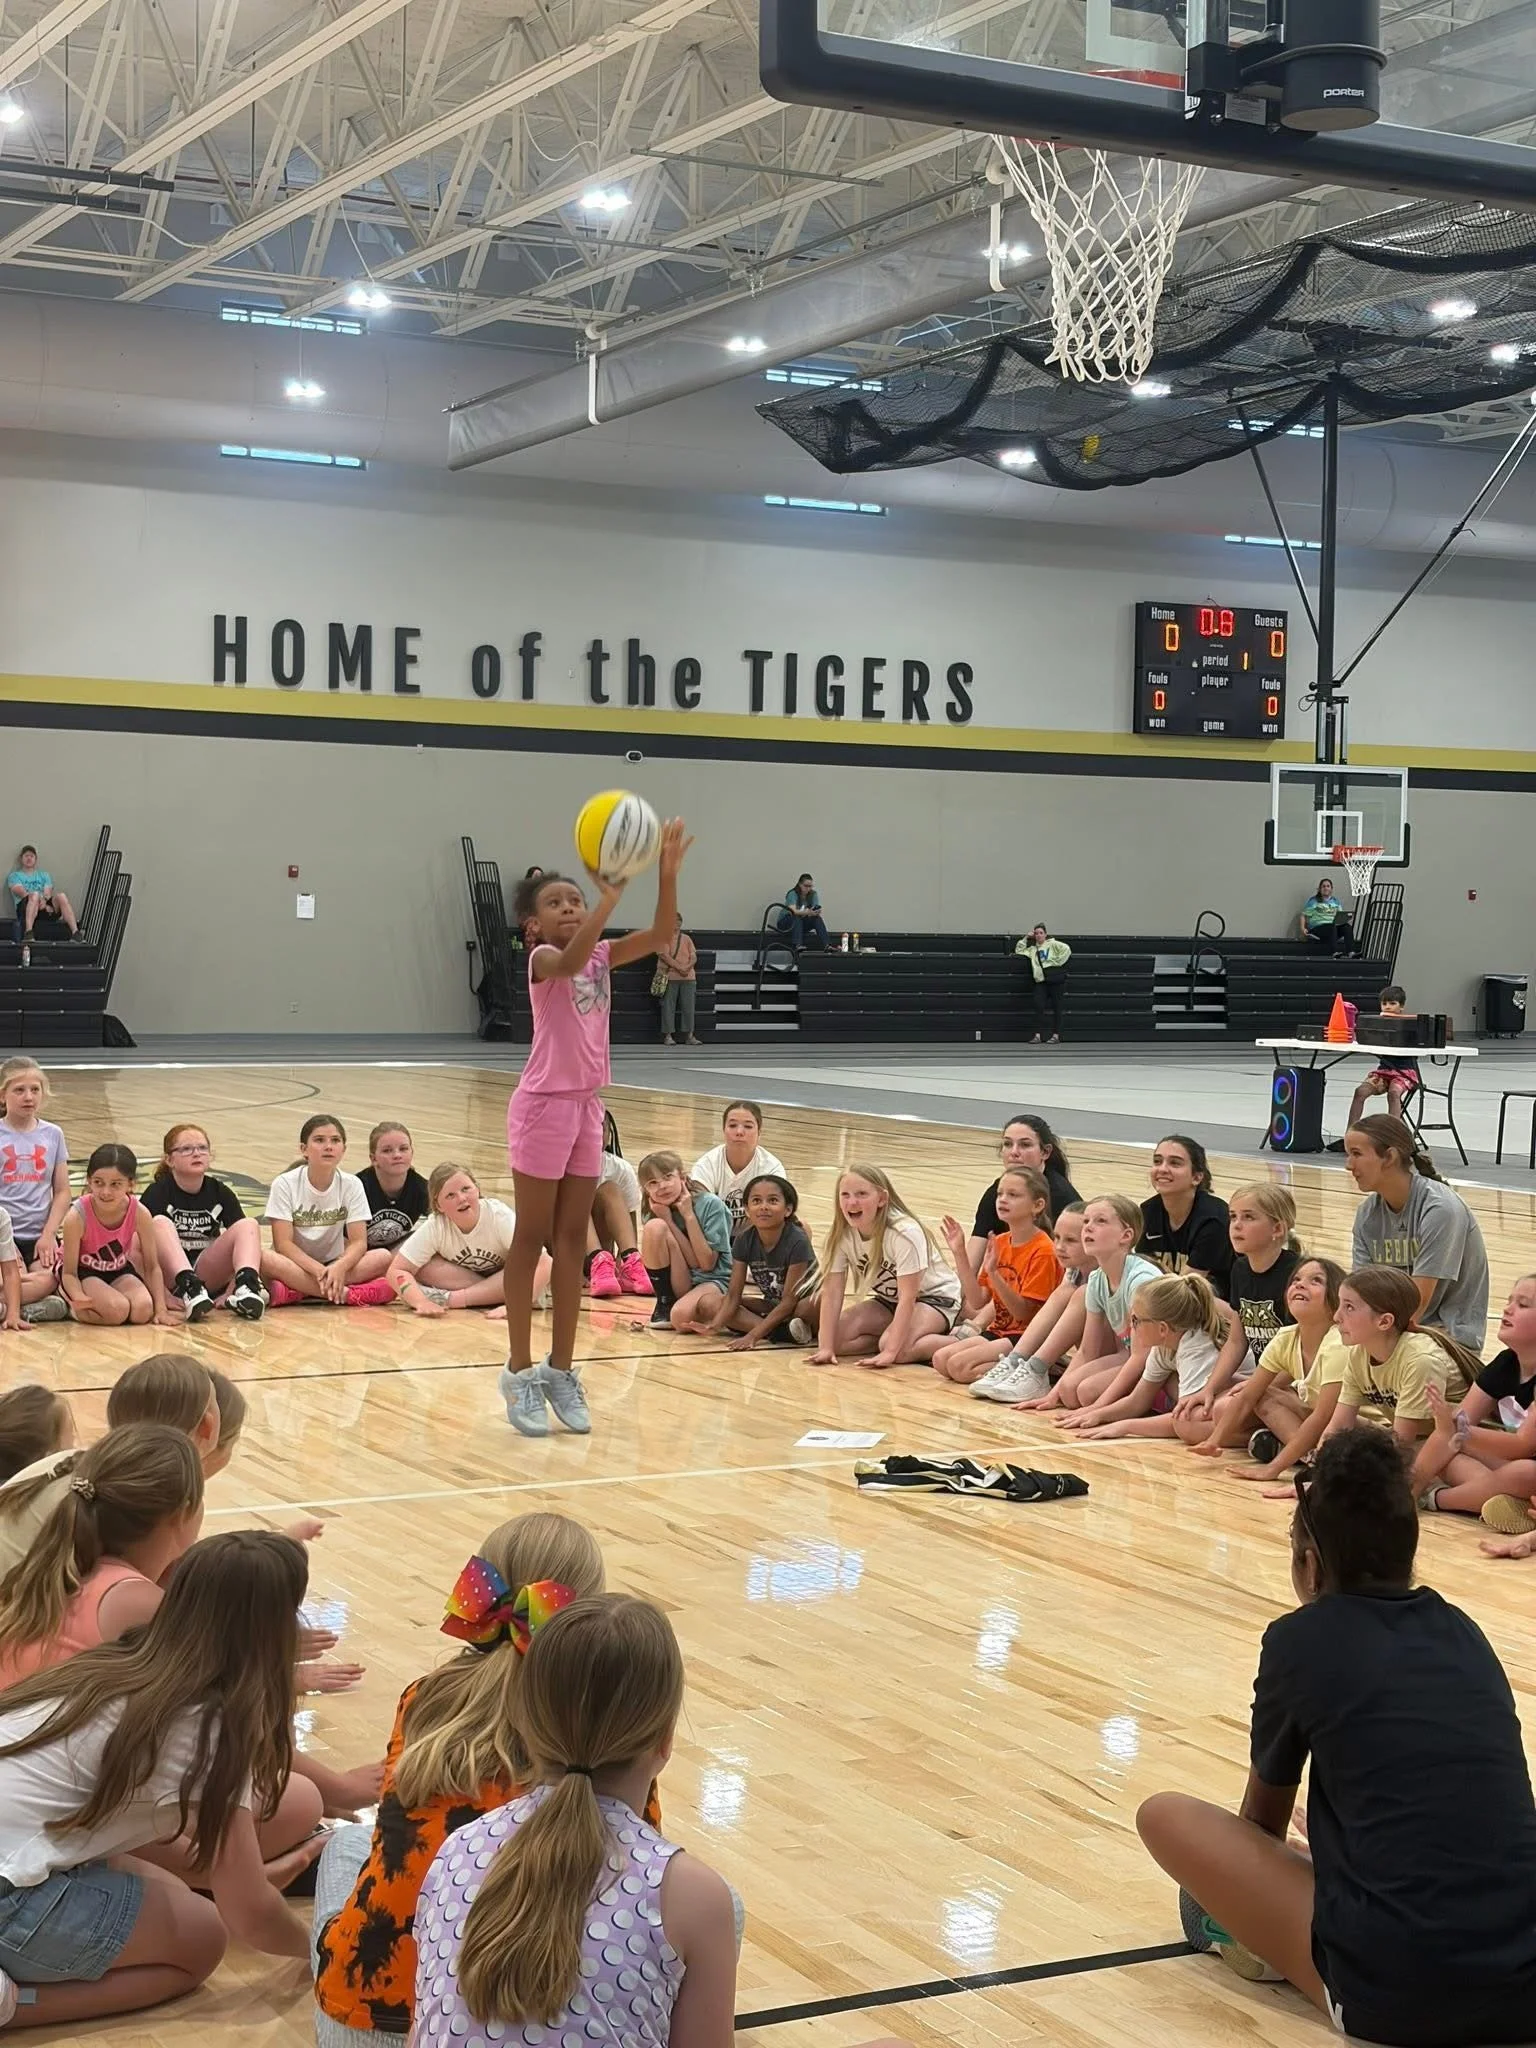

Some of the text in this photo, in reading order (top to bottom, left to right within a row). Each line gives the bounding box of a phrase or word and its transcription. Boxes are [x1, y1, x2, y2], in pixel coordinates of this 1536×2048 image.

[1151, 606, 1176, 620] Home
[1254, 614, 1284, 628] Guests
[1165, 623, 1180, 652] 0
[1270, 630, 1285, 658] 0
[1202, 654, 1229, 668] period
[212, 614, 974, 723] HOME of the TIGERS
[1148, 671, 1169, 684] fouls
[1201, 672, 1229, 688] player
[1261, 678, 1281, 690] fouls
[1154, 690, 1166, 711] 0
[1267, 696, 1278, 716] 0
[1149, 718, 1166, 728] won
[1203, 721, 1225, 733] game
[1262, 723, 1278, 733] won
